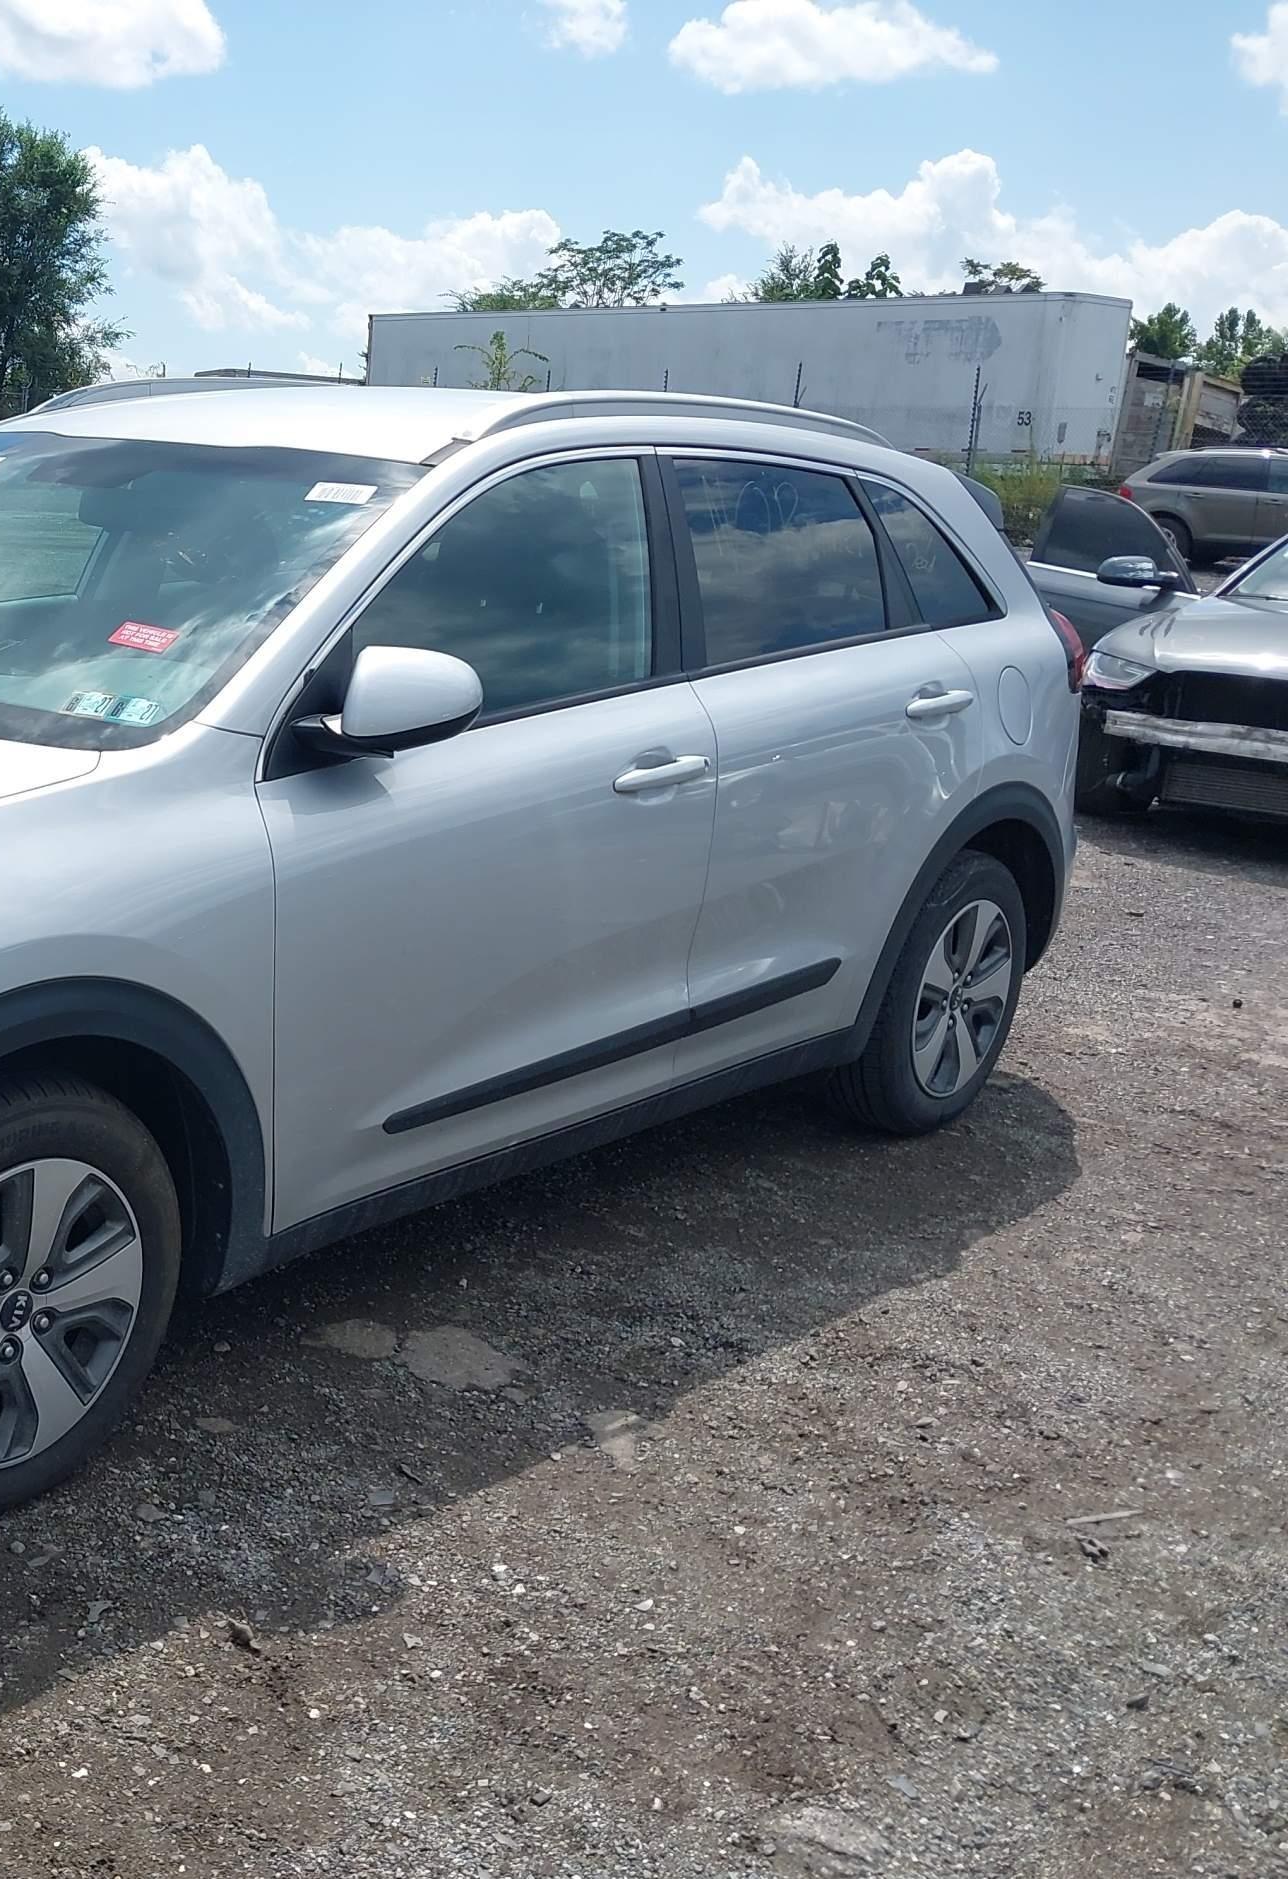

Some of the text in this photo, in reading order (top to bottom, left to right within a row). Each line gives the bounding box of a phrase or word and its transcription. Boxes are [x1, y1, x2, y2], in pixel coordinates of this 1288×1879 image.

[1017, 411, 1032, 426] 53
[135, 632, 150, 640] FOR
[150, 635, 168, 643] SALE
[7, 1295, 28, 1329] KIA
